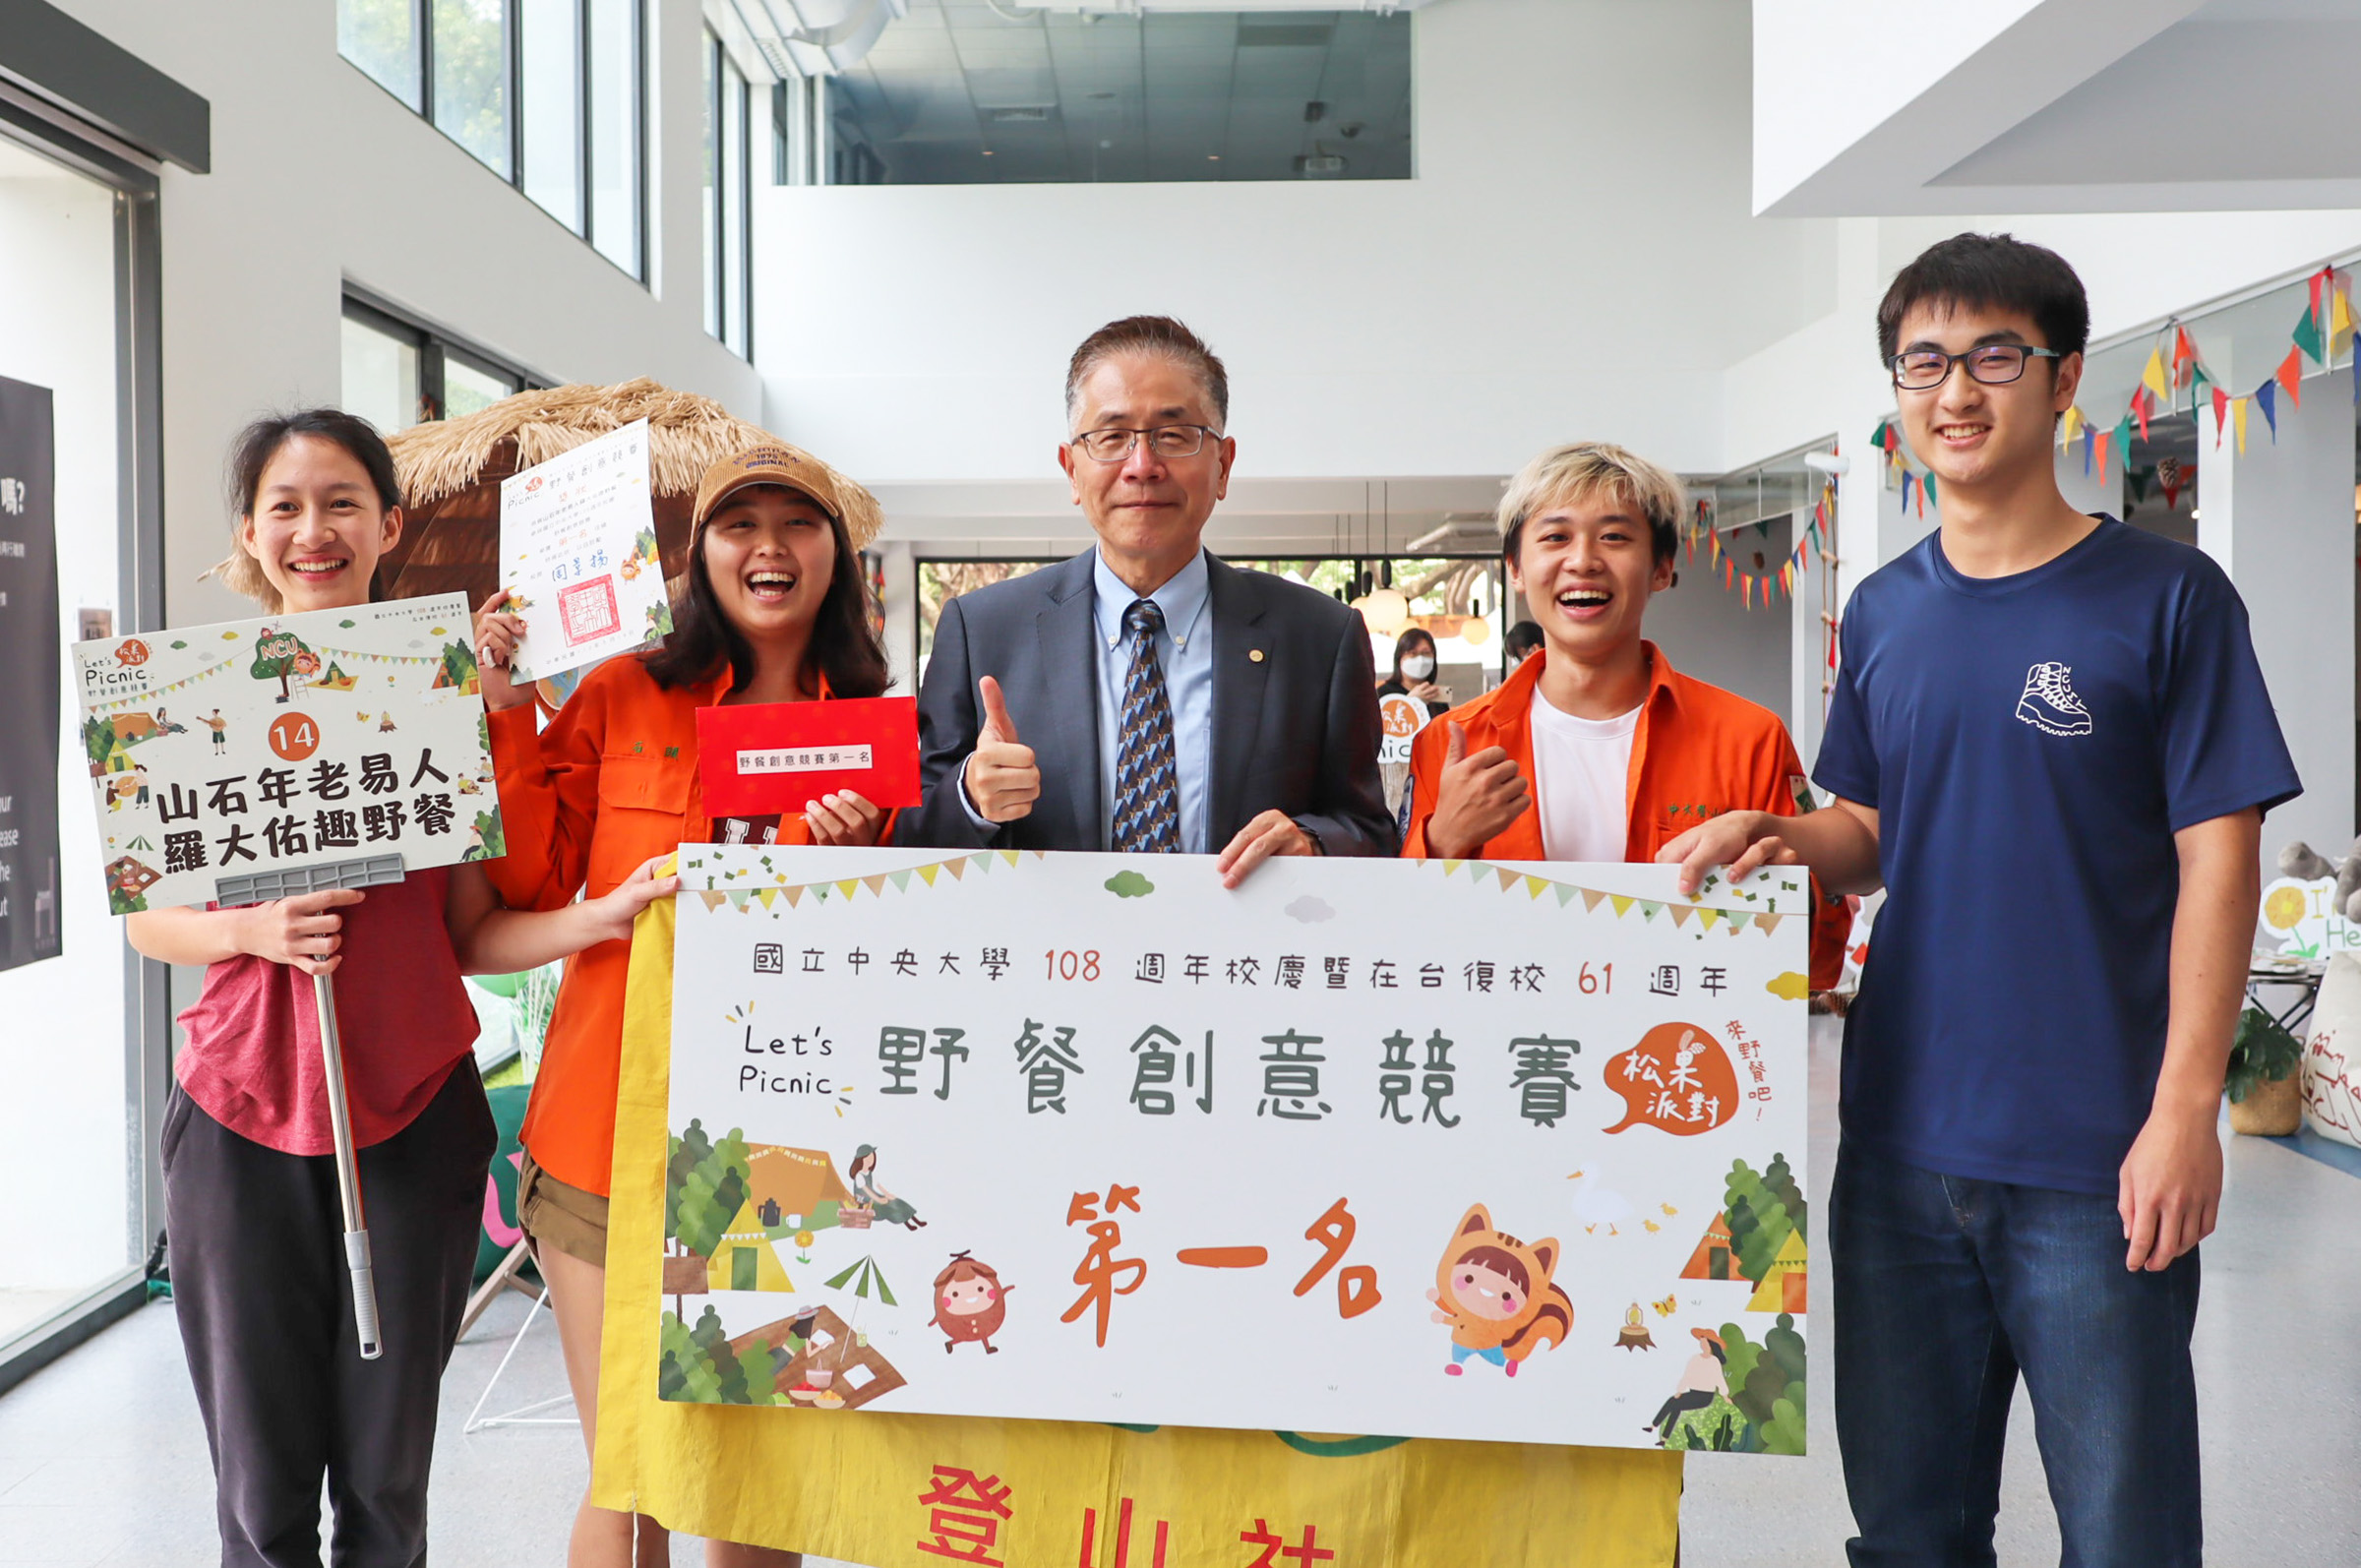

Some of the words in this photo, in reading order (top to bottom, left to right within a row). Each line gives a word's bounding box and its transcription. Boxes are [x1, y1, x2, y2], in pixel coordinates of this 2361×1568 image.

[746, 458, 790, 469] ORIGINAL
[508, 492, 540, 511] Picnic
[84, 656, 112, 669] Let's
[261, 636, 298, 662] NCU
[86, 667, 148, 688] Picnic
[273, 721, 315, 752] 14
[739, 751, 871, 769] 野餐創意競賽第一名
[156, 748, 450, 824] 山石年老易人
[163, 793, 456, 874] 羅大佑趣野餐
[754, 942, 1011, 982] 國立中央大學
[1045, 948, 1101, 982] 108
[1135, 952, 1546, 995] 週年校慶暨在台復校
[1578, 960, 1613, 996] 61
[1648, 964, 1728, 998] 週年
[745, 1024, 834, 1056] Let's
[740, 1064, 833, 1095] Picnic
[878, 1017, 1582, 1129] 野餐創意競賽
[1622, 1049, 1705, 1095] 松果
[1645, 1090, 1722, 1128] 派對
[1059, 1183, 1382, 1349] 第一名
